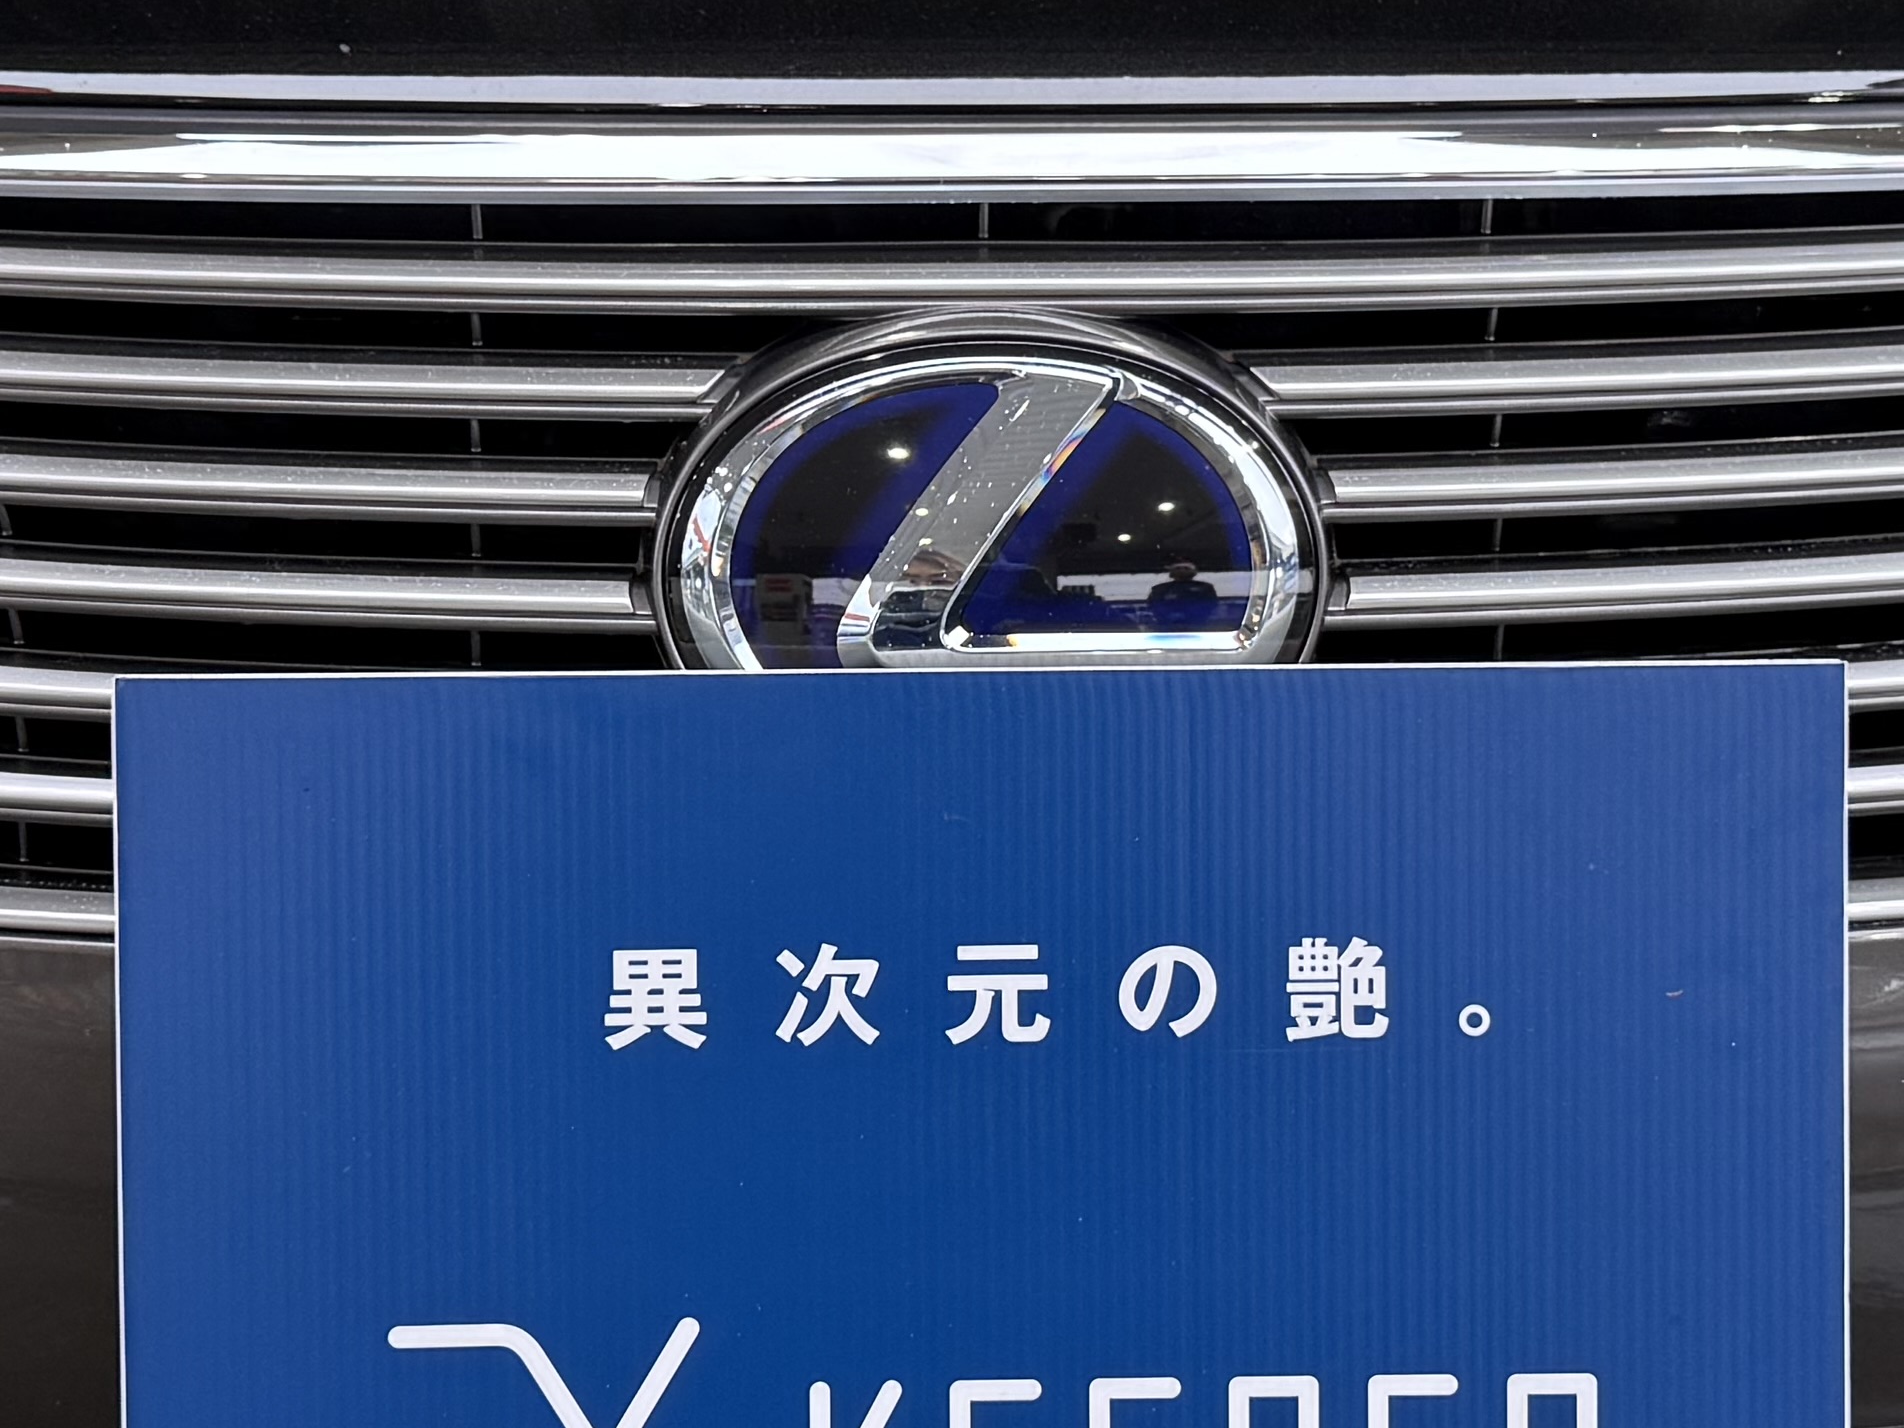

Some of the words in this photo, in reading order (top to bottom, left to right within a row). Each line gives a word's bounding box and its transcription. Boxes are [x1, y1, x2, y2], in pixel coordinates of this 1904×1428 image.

[603, 935, 1492, 1052] 異次元の艶。
